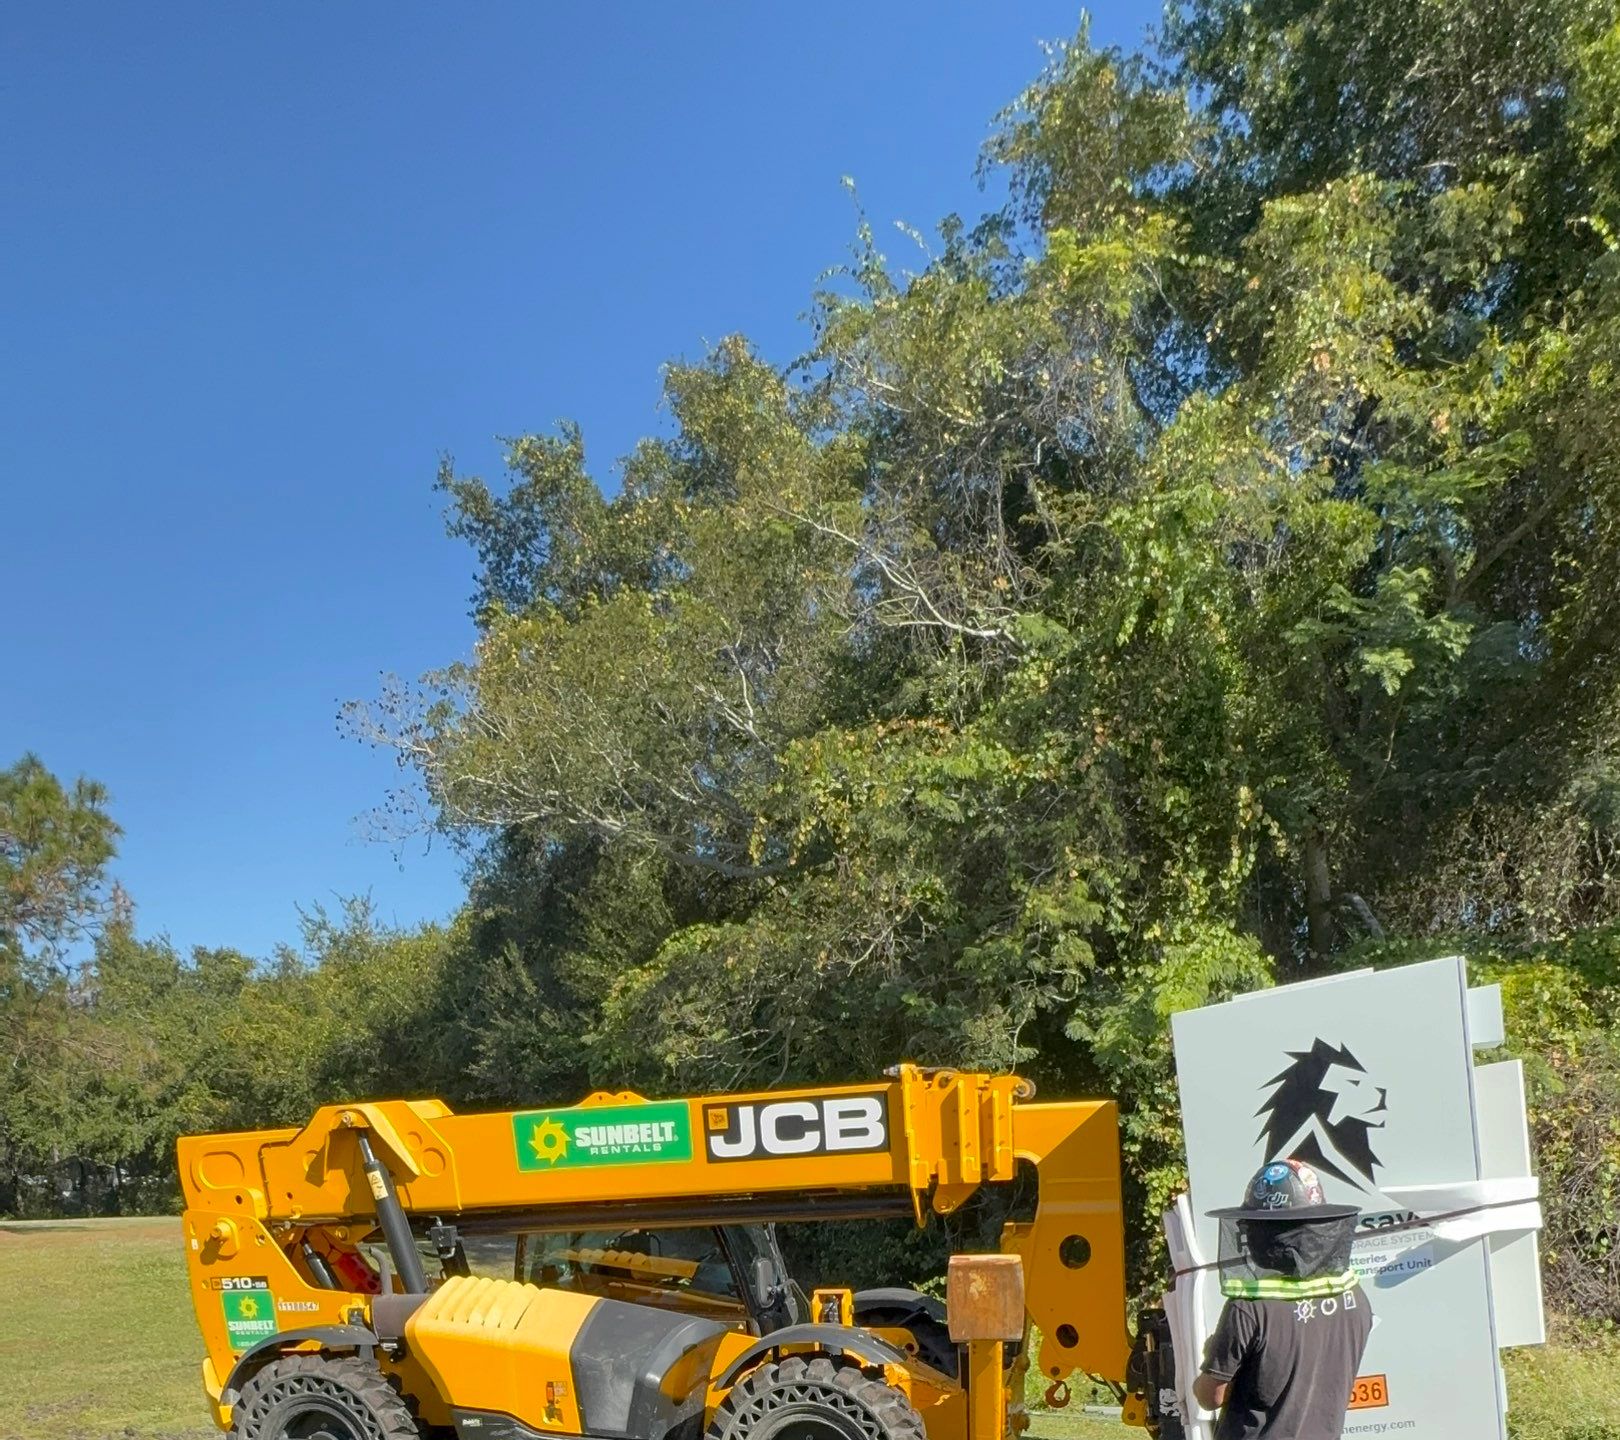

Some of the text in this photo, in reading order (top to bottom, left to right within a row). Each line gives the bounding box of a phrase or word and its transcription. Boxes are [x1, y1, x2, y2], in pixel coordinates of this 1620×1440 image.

[575, 1121, 675, 1147] SUNBELT
[709, 1097, 885, 1158] JCB
[590, 1143, 662, 1156] RENTALS
[1350, 1236, 1388, 1250] ORAGE
[1350, 1254, 1388, 1267] tteries
[1354, 1258, 1432, 1275] ransport Unit
[1342, 1420, 1416, 1434] nenergy.com
